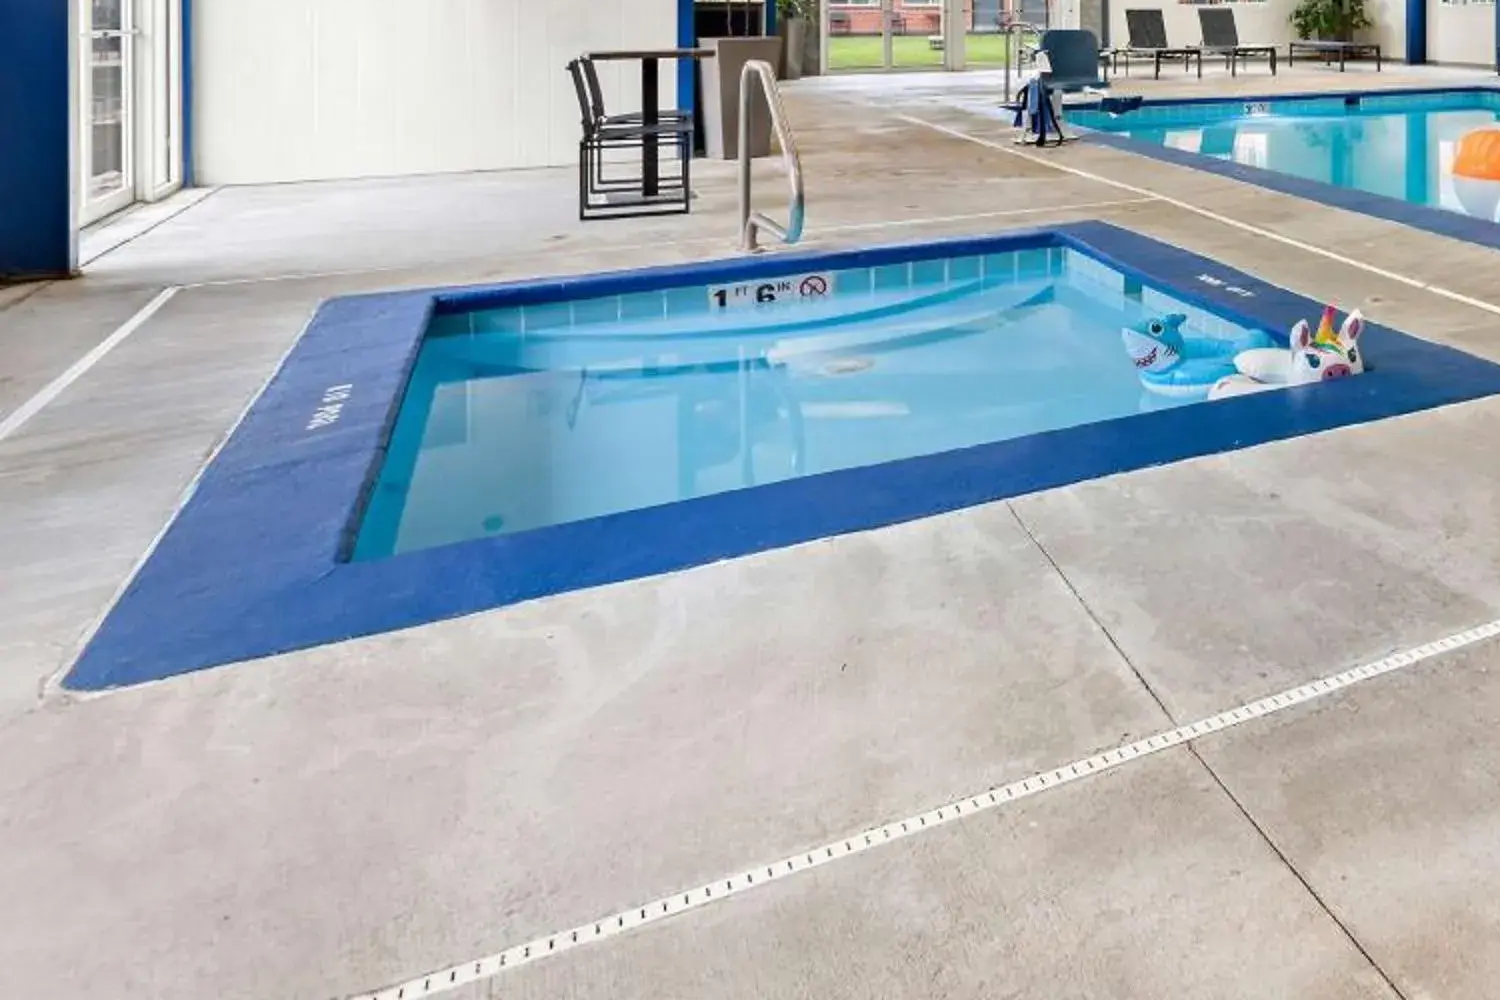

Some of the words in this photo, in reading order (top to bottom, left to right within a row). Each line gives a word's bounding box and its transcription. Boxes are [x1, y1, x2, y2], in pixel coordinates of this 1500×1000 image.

[714, 289, 727, 307] 1
[735, 287, 747, 296] FT
[757, 284, 776, 303] 6
[777, 281, 791, 292] IN
